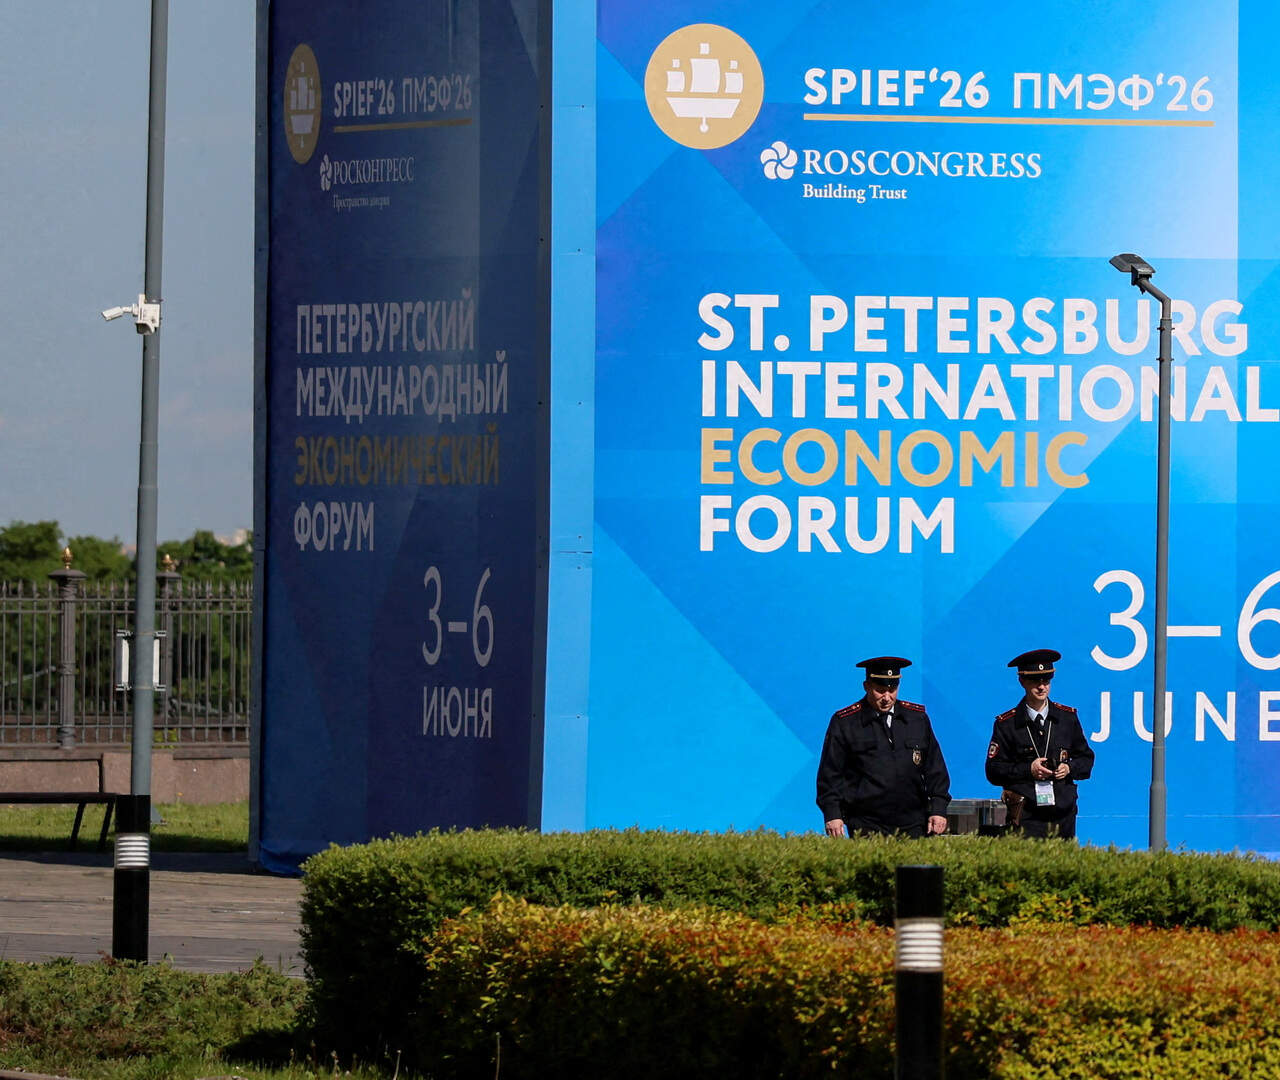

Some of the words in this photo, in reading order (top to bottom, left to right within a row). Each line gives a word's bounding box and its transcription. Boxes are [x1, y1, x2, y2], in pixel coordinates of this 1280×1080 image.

[803, 67, 990, 109] SPIEF‘26
[1013, 72, 1214, 113] ПМЭФ‘26
[333, 156, 415, 185] РОСКОНГРЕСС
[802, 149, 1042, 178] ROSCONGRESS
[803, 183, 866, 204] Building
[868, 184, 908, 200] Trust
[296, 288, 475, 354] ПЕТЕРБУРГСКИЙ
[697, 292, 790, 352] ST.
[809, 294, 1248, 357] PETERSBURG
[296, 351, 509, 424] МЕЖДУНАРОДНЫЙ
[701, 360, 1280, 423] INTERNATIONAL
[294, 424, 500, 486] ЭКОНОМИЧЕСКИЙ
[701, 427, 1090, 489] ECONOMIC
[294, 501, 374, 551] ФОРУМ
[700, 494, 955, 554] FORUM
[422, 566, 494, 668] 3–6
[422, 686, 493, 739] ИЮНЯ
